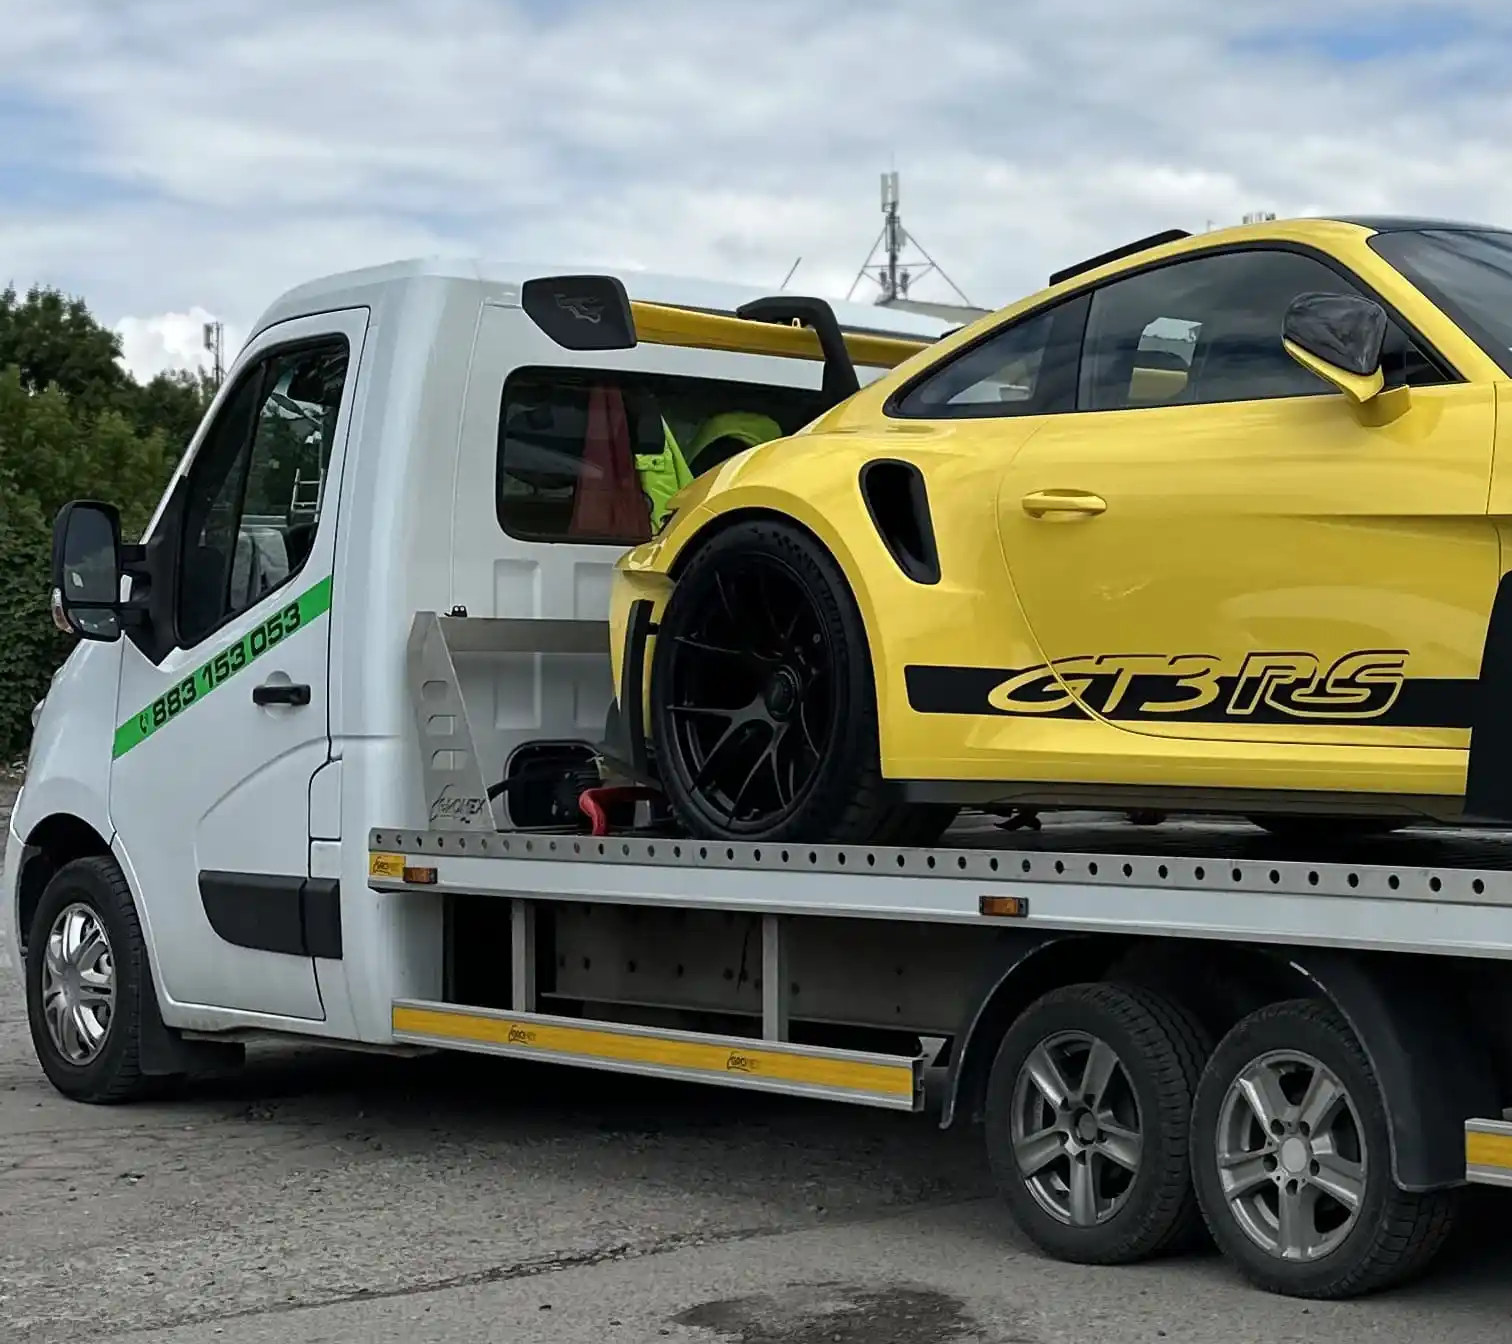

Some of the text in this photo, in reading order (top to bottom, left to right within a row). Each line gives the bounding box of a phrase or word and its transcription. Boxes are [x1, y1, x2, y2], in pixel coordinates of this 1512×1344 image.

[152, 602, 301, 727] 883 153 053
